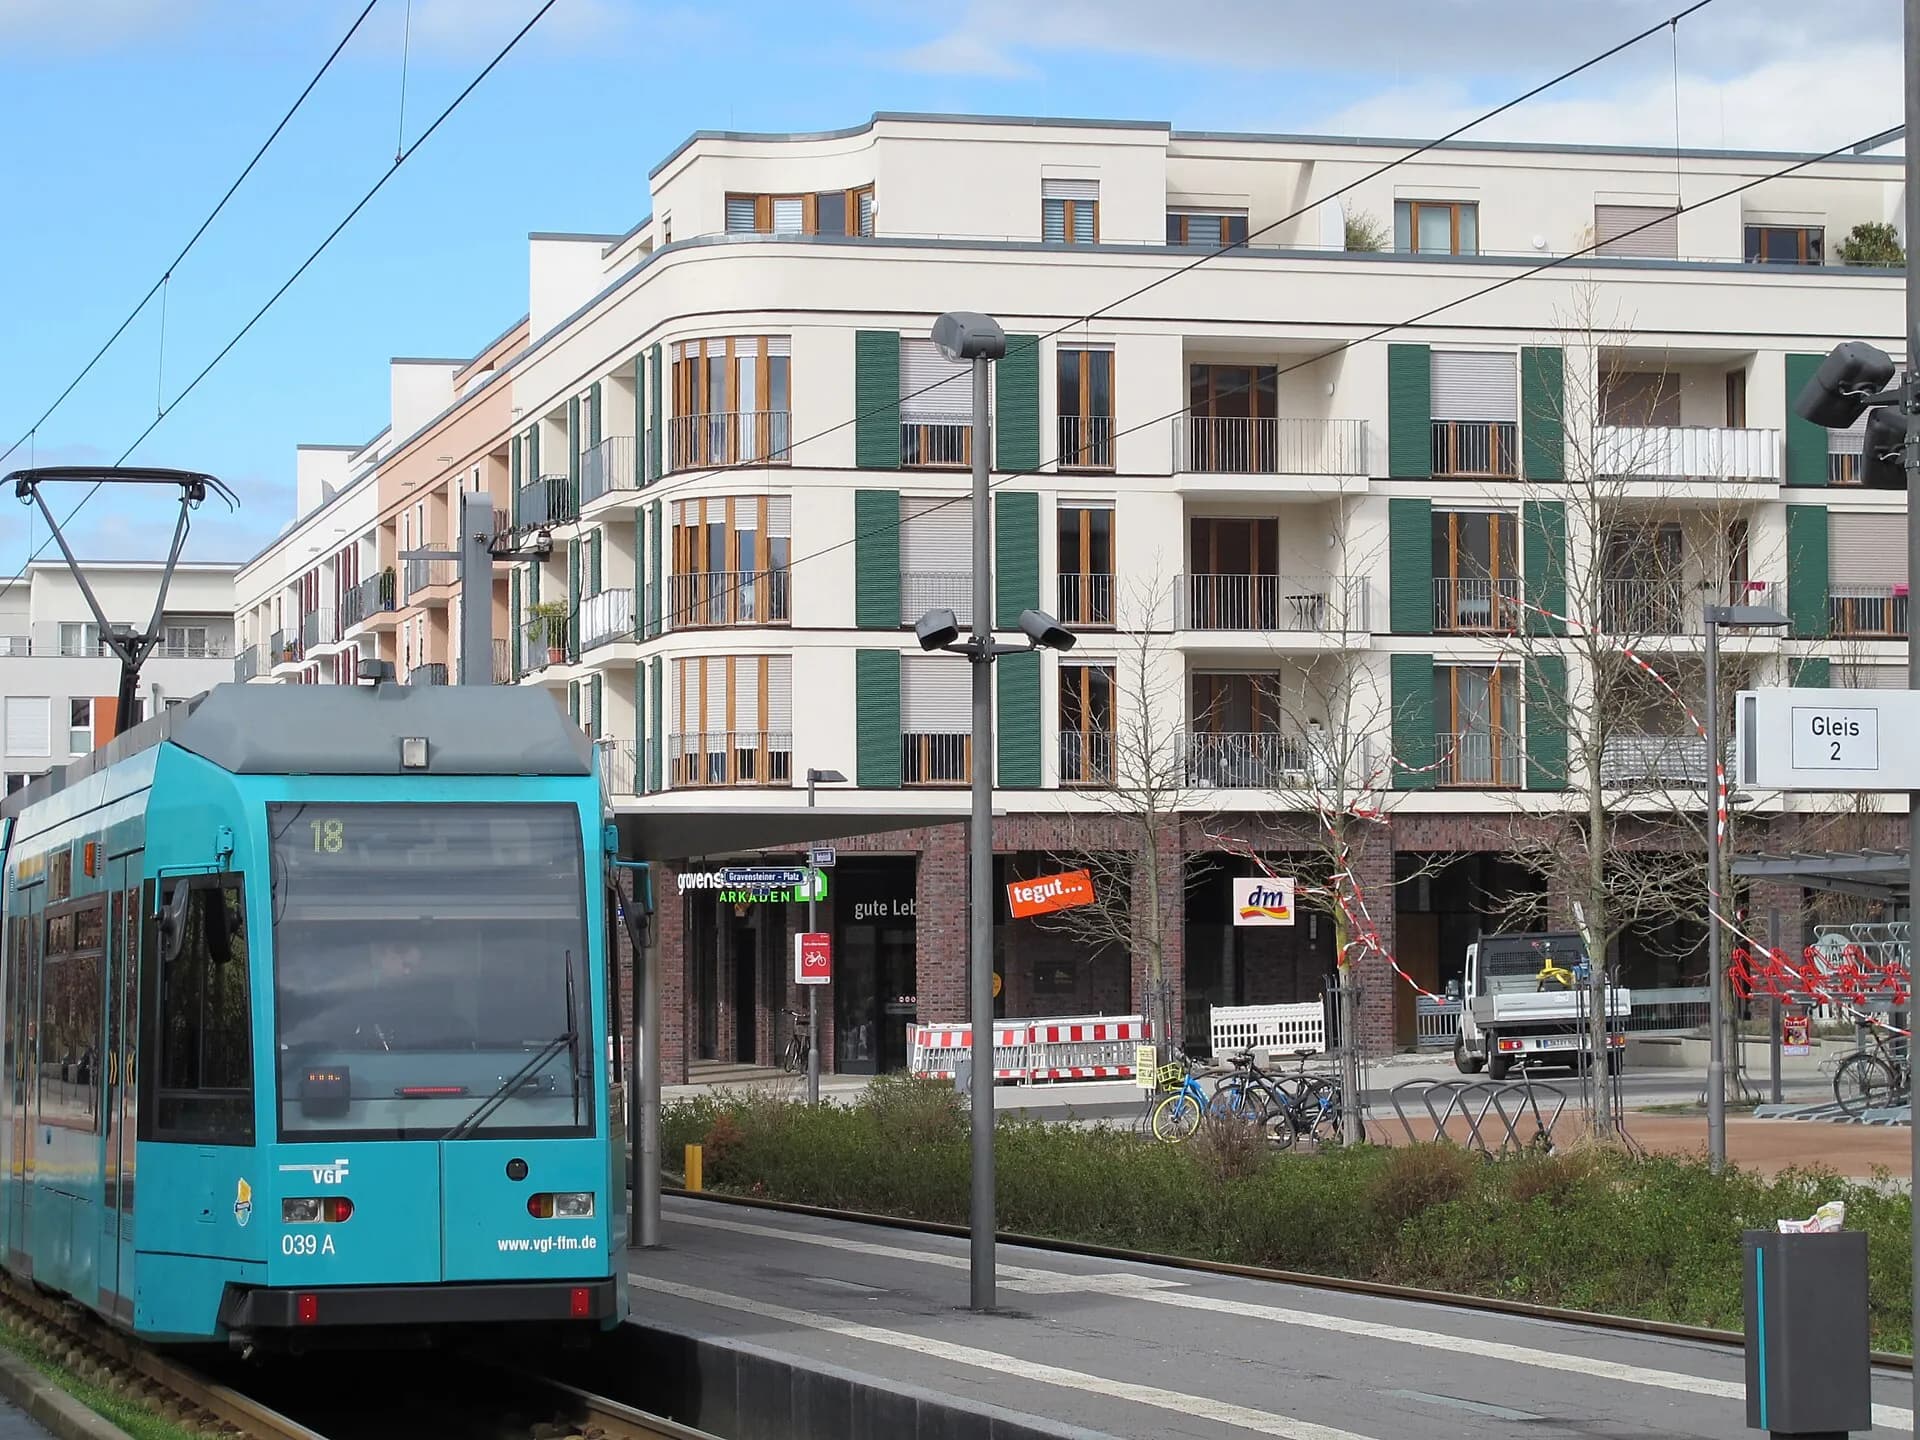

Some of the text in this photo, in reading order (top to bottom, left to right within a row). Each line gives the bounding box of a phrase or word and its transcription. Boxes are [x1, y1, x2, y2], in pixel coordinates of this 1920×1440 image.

[1811, 716, 1860, 737] Gleis
[1830, 741, 1842, 761] 2
[310, 819, 343, 853] 18
[729, 872, 776, 881] Gravensteiner
[783, 872, 800, 881] Platz
[1013, 879, 1083, 904] tegut...
[1248, 885, 1283, 907] dm
[855, 899, 887, 920] gute
[312, 1158, 349, 1184] VGF
[282, 1233, 336, 1255] 039 A
[497, 1235, 598, 1254] www.vgf-ffm.de
